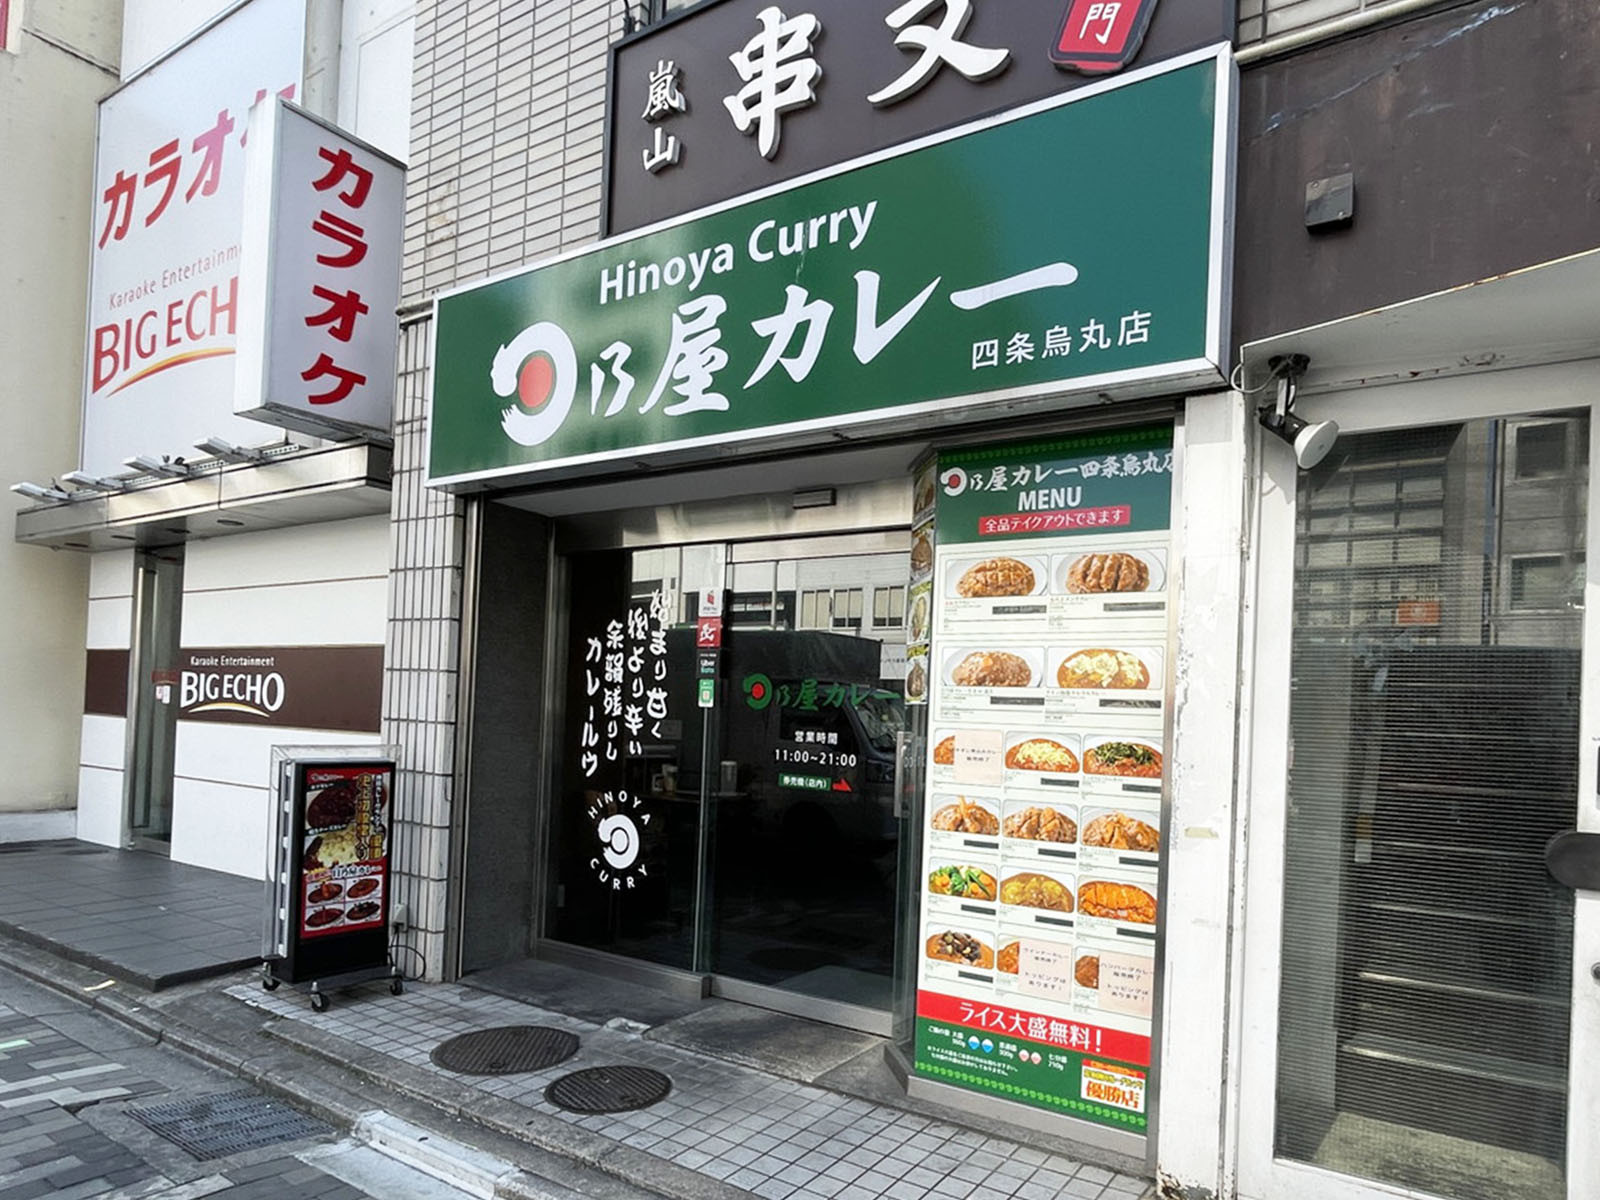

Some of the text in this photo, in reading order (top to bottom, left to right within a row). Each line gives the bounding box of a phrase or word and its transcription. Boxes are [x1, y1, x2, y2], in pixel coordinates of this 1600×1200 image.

[641, 59, 686, 174] 嵐山
[98, 83, 297, 250] カラオ
[301, 147, 374, 405] カラオケ
[600, 200, 878, 304] Hinoya Curry
[109, 244, 242, 311] Karaoke Entertainm
[92, 310, 158, 394] BIG
[971, 310, 1153, 369] 四条烏丸店
[985, 508, 1124, 533] 全品テイクアウトできます
[1018, 486, 1082, 511] MENU
[191, 655, 275, 666] Karaoke Entertainment
[180, 670, 285, 711] BIG ECHO
[794, 730, 838, 745] 営業時間
[587, 790, 652, 826] HINOYA
[589, 857, 648, 890] CURRY
